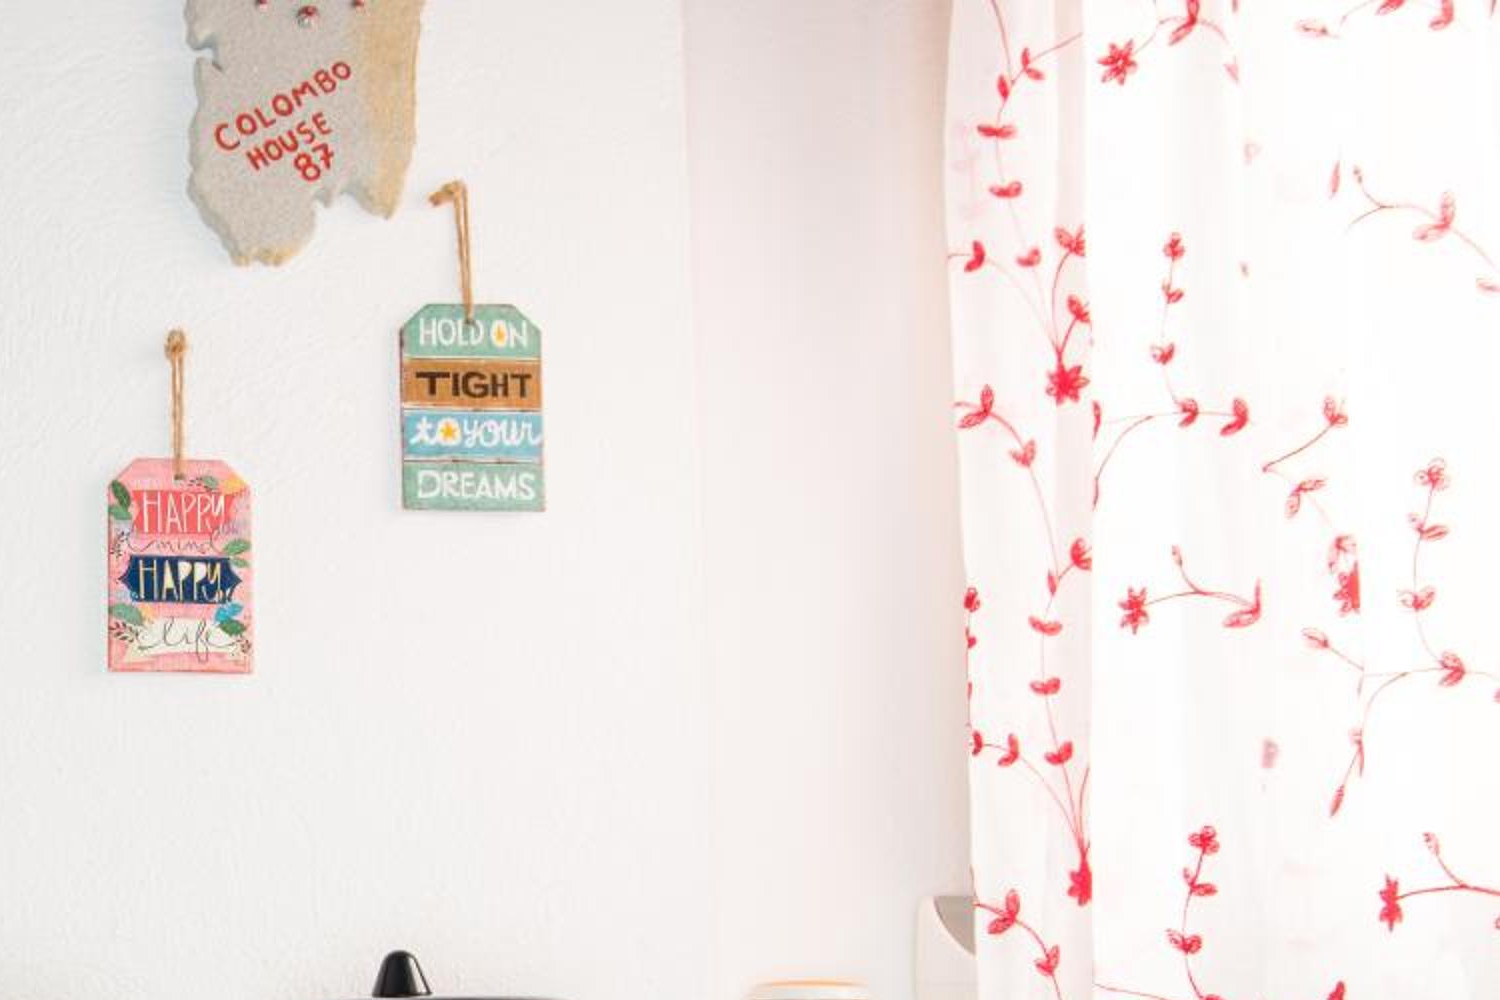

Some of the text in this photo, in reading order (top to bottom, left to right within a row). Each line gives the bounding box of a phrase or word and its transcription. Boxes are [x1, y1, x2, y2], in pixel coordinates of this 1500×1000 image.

[213, 61, 352, 152] COLOMBO
[245, 112, 333, 171] HOUSE
[293, 143, 336, 183] 87
[419, 317, 529, 348] HOLD ON
[415, 371, 532, 398] TIGHT
[409, 416, 541, 449] to your
[416, 470, 536, 500] DREAMS
[142, 491, 227, 534] HAPPY
[138, 558, 222, 601] HAPPY
